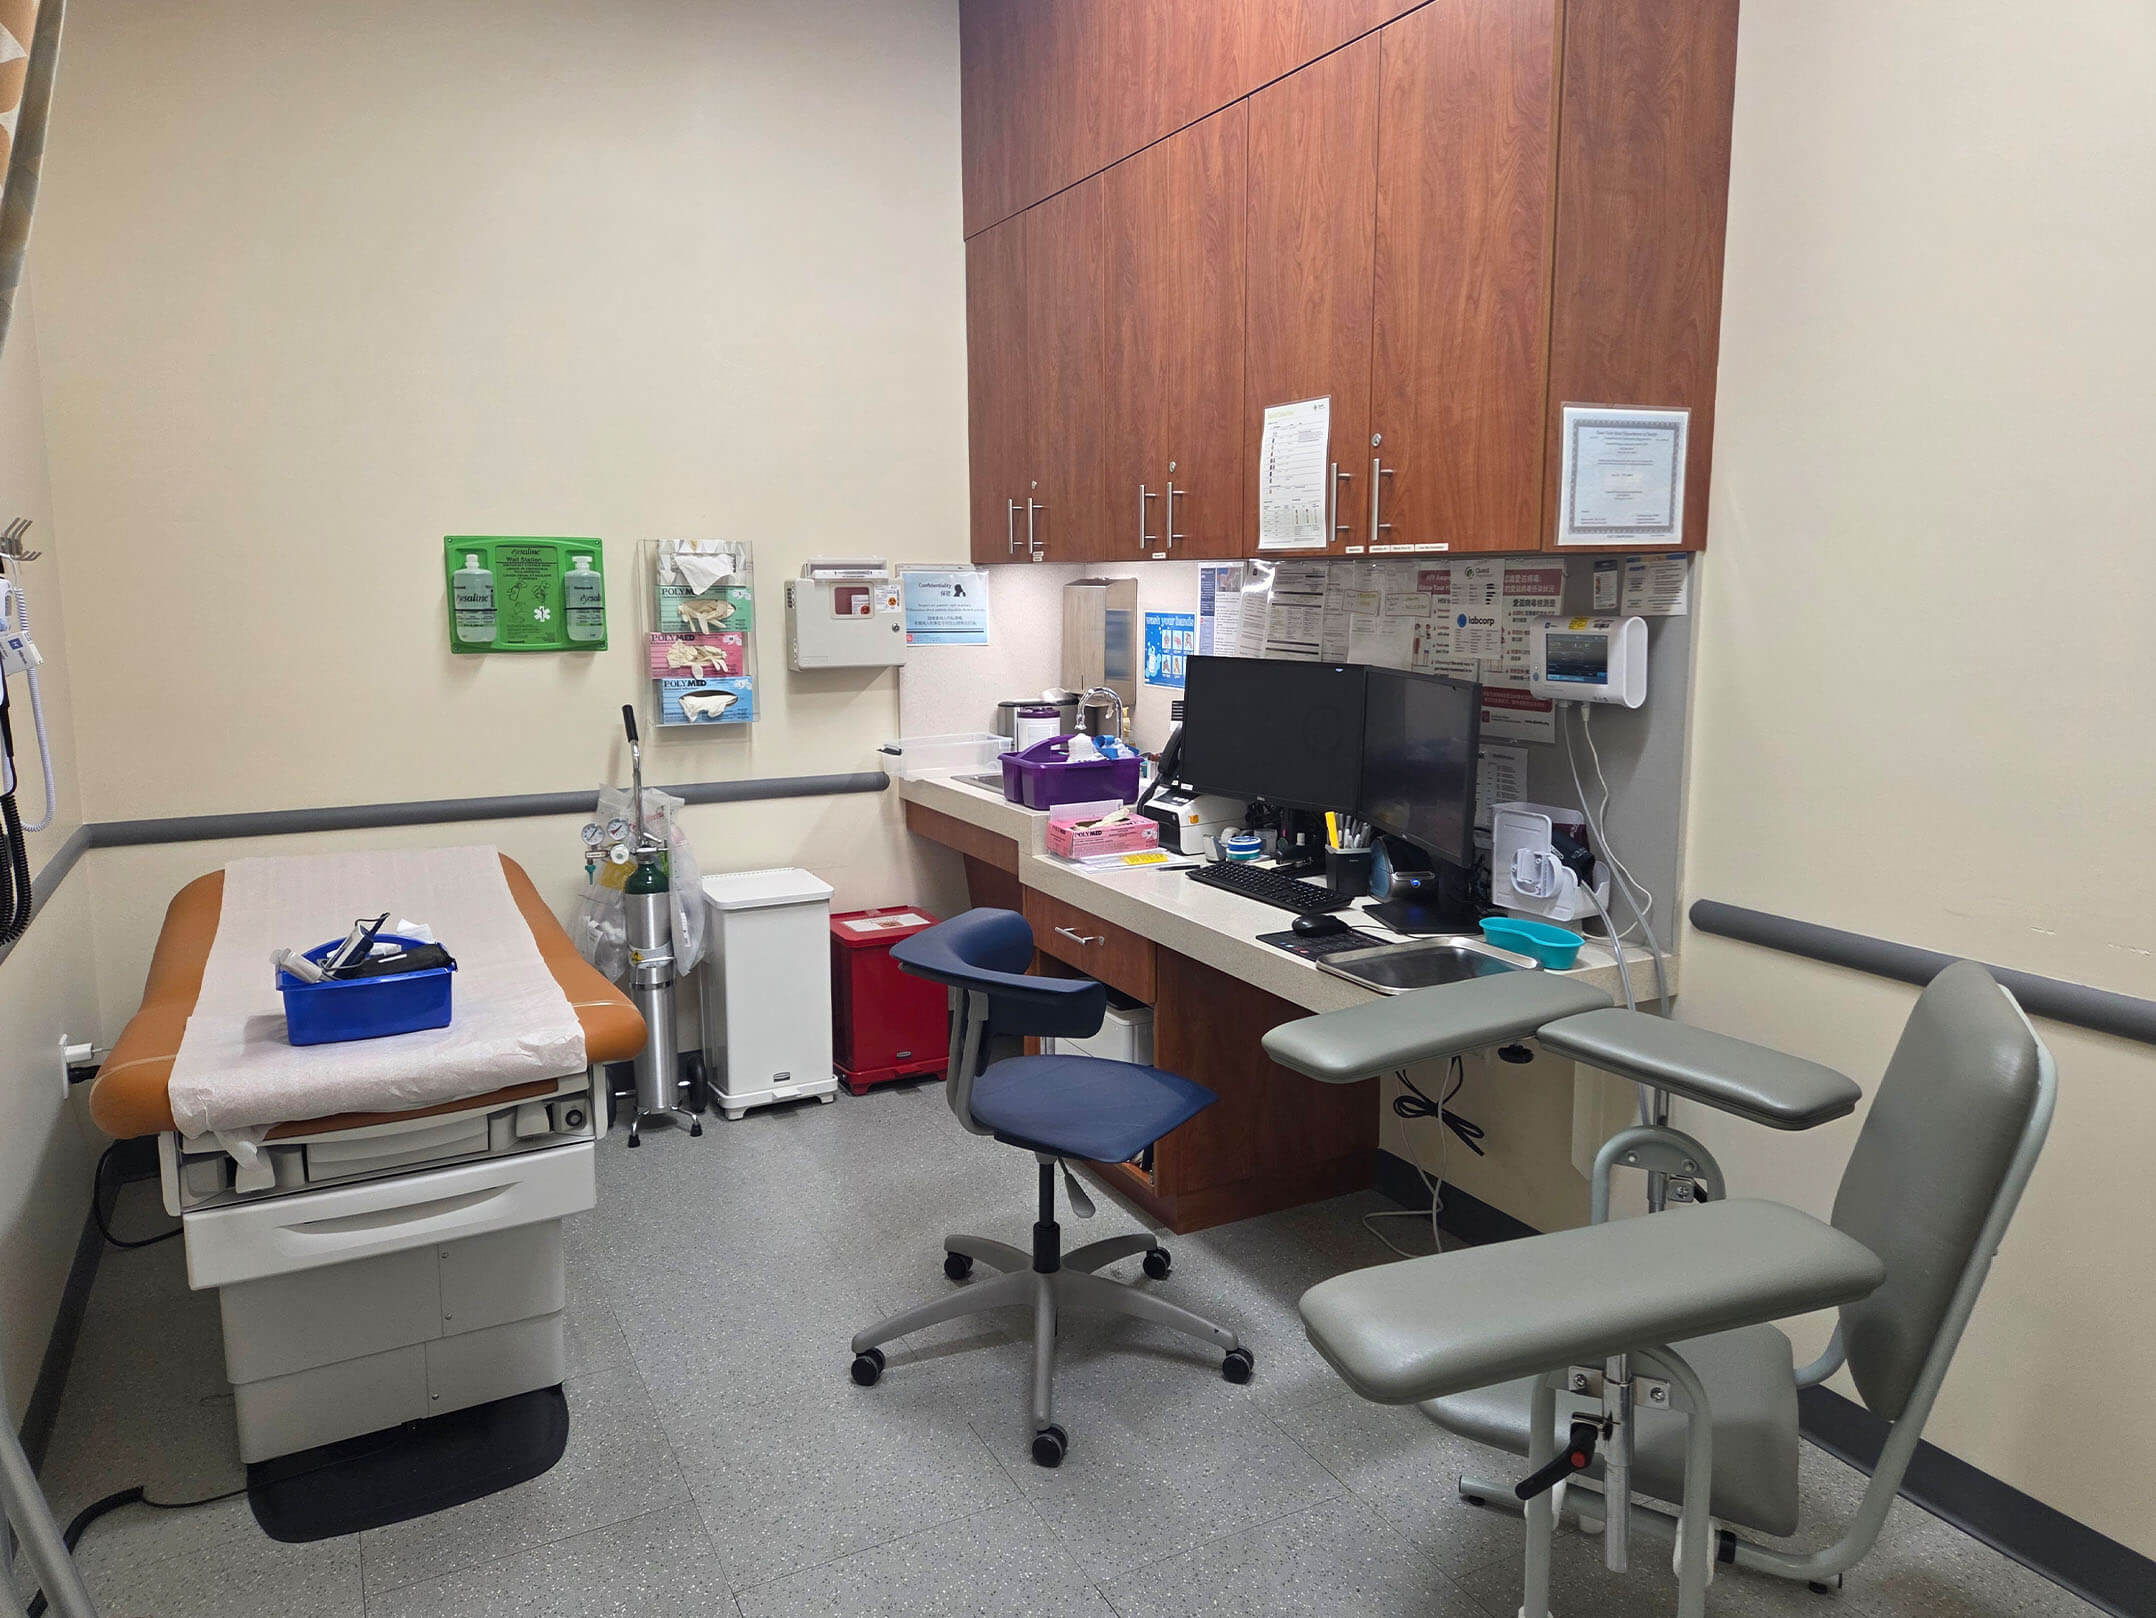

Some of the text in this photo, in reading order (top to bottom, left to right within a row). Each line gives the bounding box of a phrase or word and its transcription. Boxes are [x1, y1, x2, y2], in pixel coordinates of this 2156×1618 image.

[1161, 617, 1175, 627] your
[1468, 616, 1495, 626] labcorp
[651, 634, 696, 642] POLYMED
[664, 679, 707, 688] POLYMED
